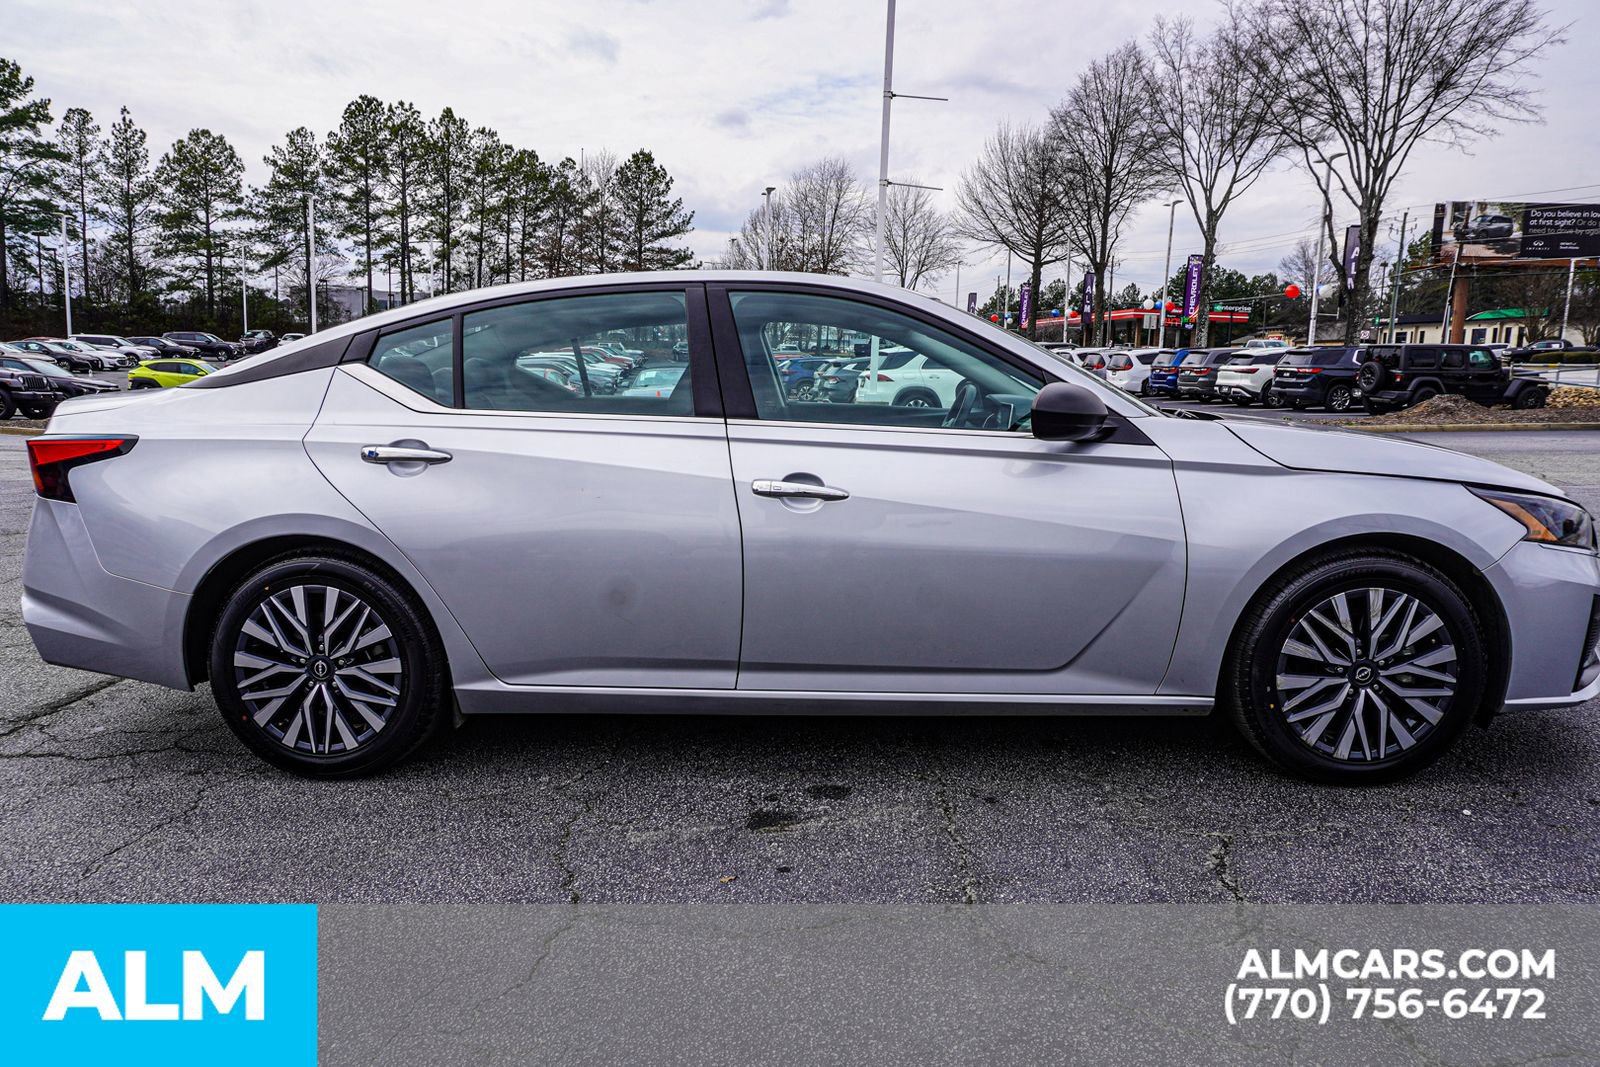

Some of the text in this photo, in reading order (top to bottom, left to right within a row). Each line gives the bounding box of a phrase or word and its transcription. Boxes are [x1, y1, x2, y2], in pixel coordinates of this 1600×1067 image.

[1530, 209, 1541, 217] Do
[1538, 218, 1553, 226] first
[1554, 218, 1576, 227] sight?
[1188, 267, 1199, 315] CHEVROLET
[1083, 285, 1092, 313] ALM
[1215, 304, 1252, 313] enterprise
